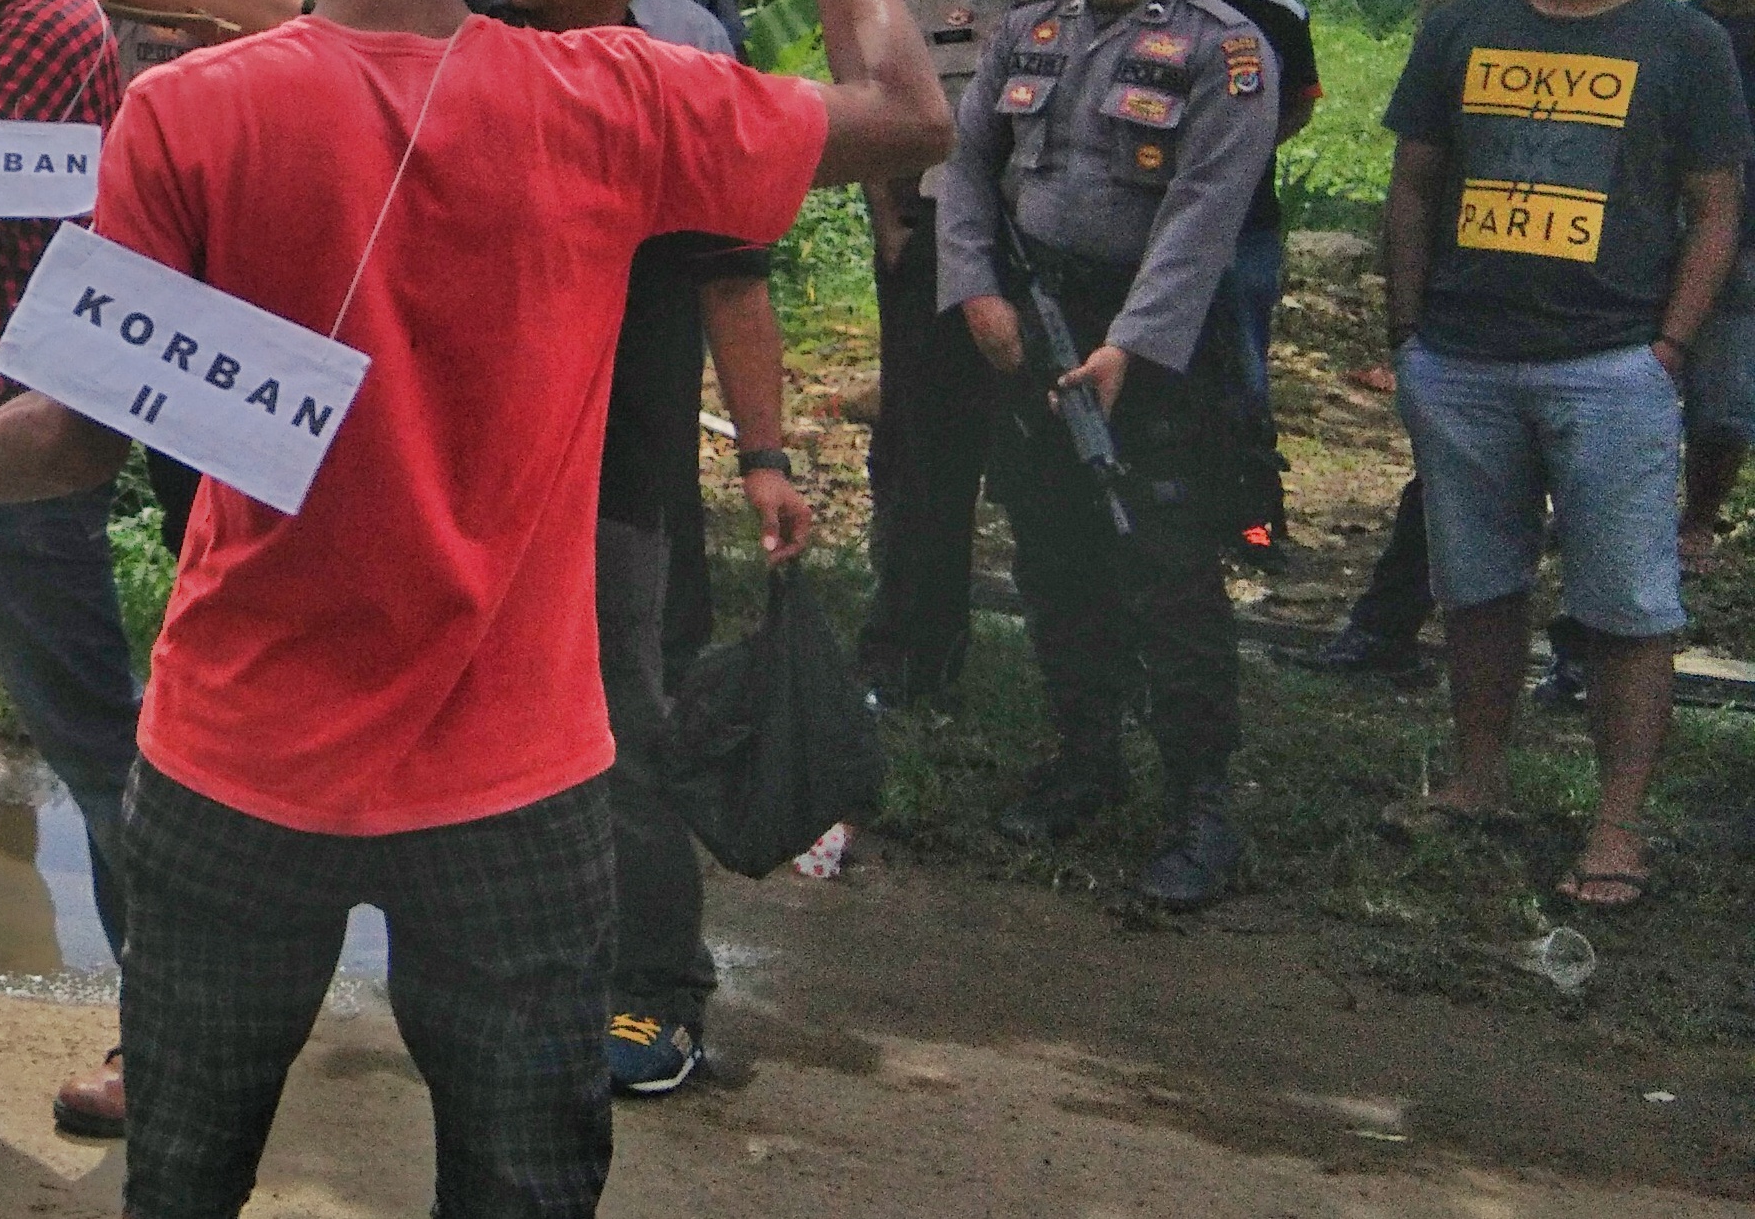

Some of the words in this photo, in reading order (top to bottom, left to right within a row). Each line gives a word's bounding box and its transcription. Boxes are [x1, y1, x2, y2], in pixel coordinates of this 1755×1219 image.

[1479, 63, 1622, 100] TOKYO
[1461, 203, 1591, 245] PARIS
[72, 286, 333, 437] KORBAN
[129, 385, 168, 425] II
